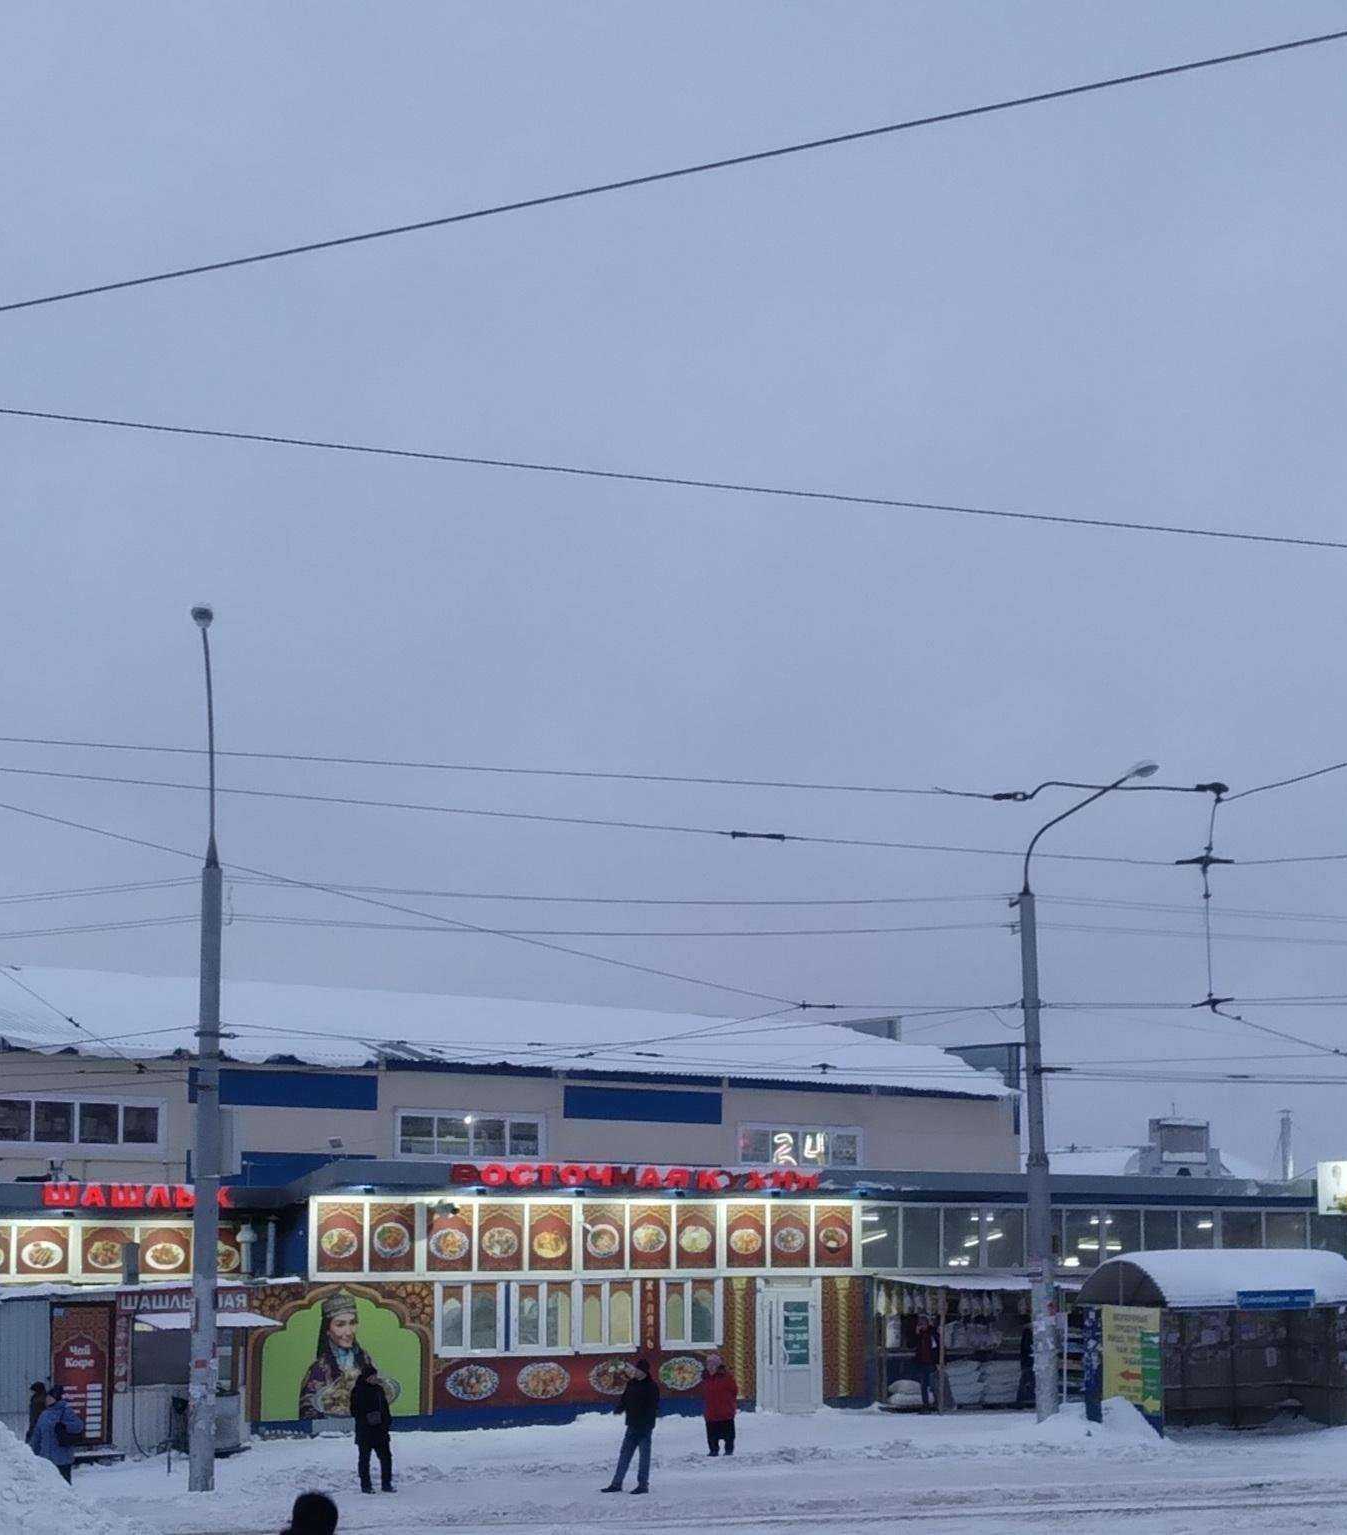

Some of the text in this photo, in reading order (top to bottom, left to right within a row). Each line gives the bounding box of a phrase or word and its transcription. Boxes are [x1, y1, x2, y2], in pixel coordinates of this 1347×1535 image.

[451, 1163, 690, 1188] ВОСТОЧНАЯ
[69, 1344, 91, 1355] Чай
[64, 1358, 95, 1370] Кофе
